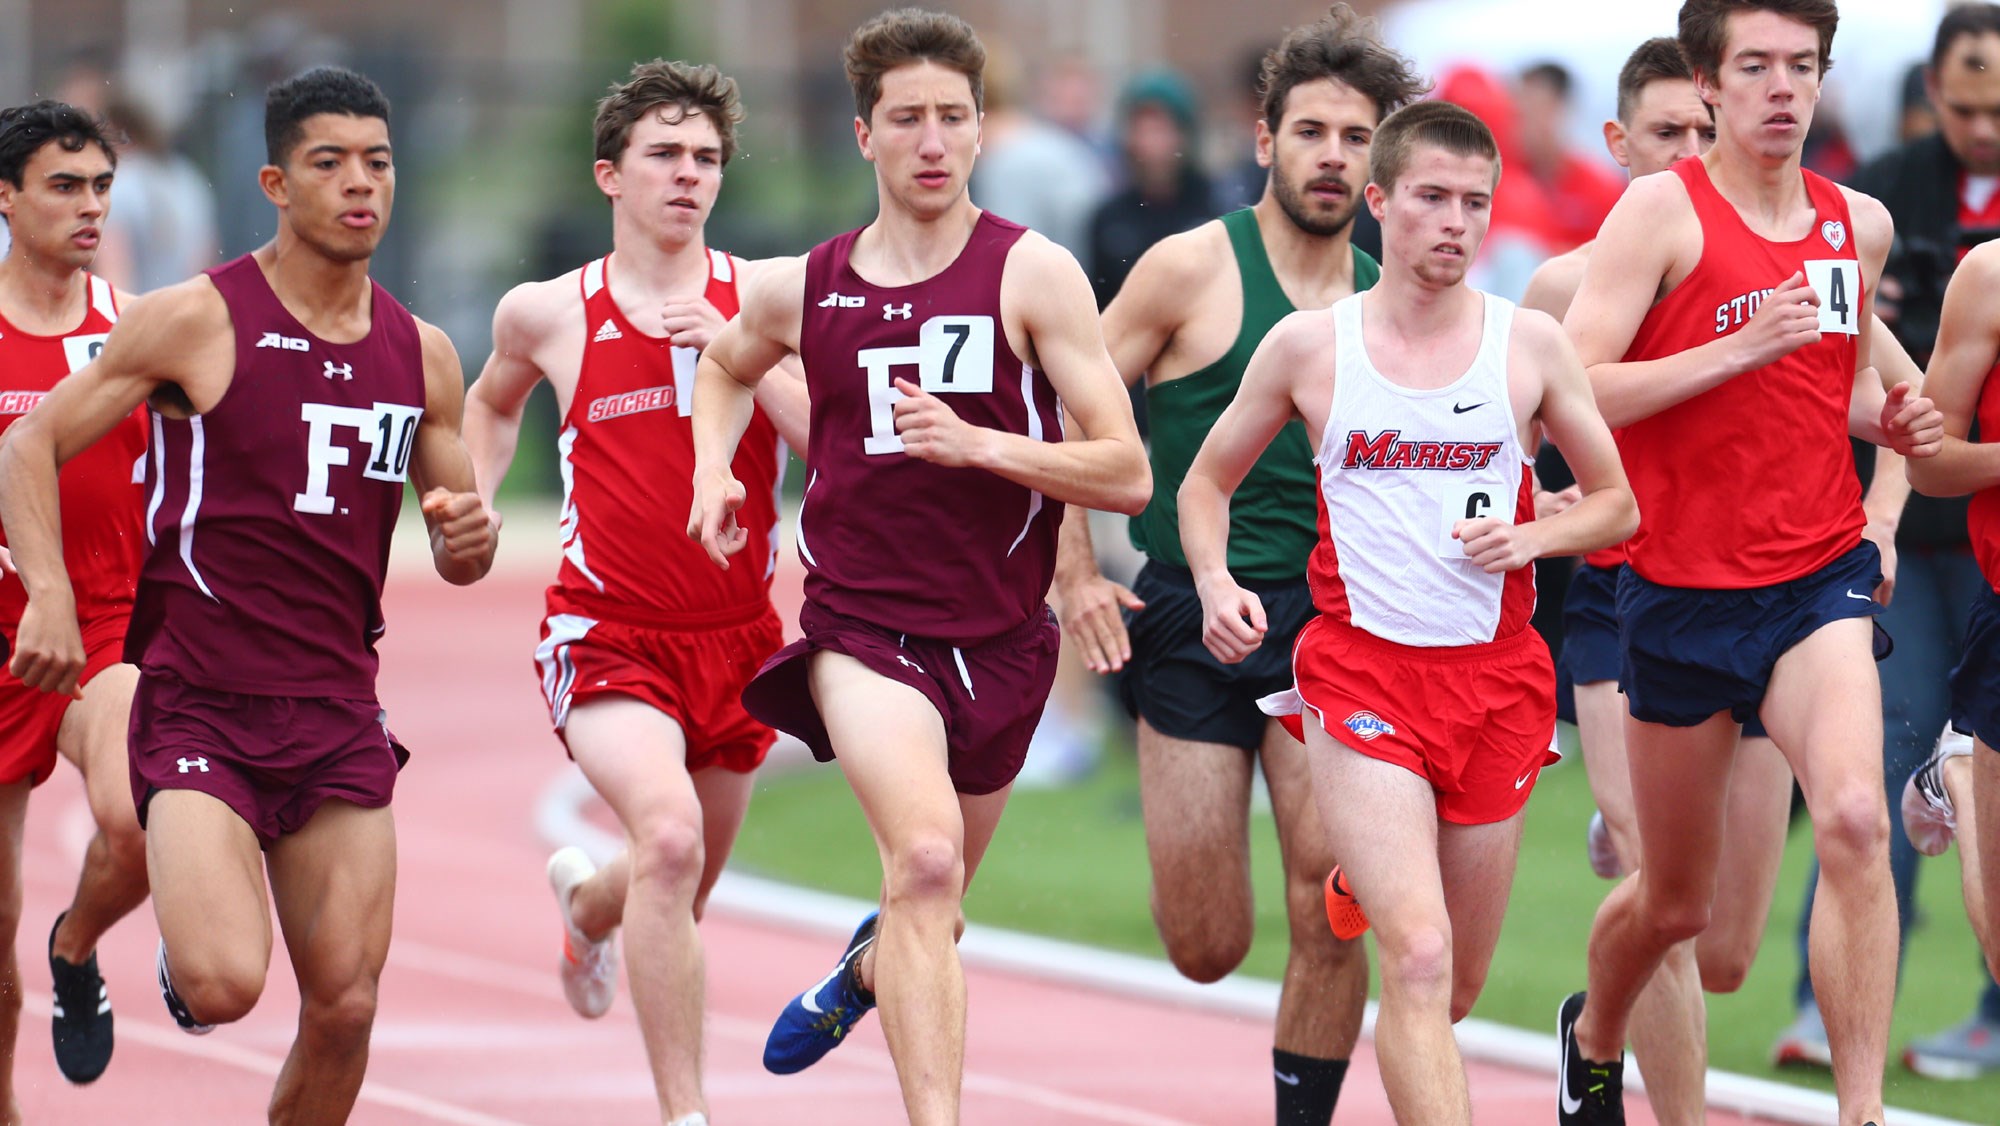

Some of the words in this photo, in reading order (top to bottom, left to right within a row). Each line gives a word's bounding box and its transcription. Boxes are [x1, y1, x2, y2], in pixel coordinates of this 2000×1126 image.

[1830, 267, 1849, 325] 4
[942, 324, 970, 384] 7
[587, 385, 675, 423] SACRED
[293, 402, 375, 515] F
[370, 413, 416, 475] 10
